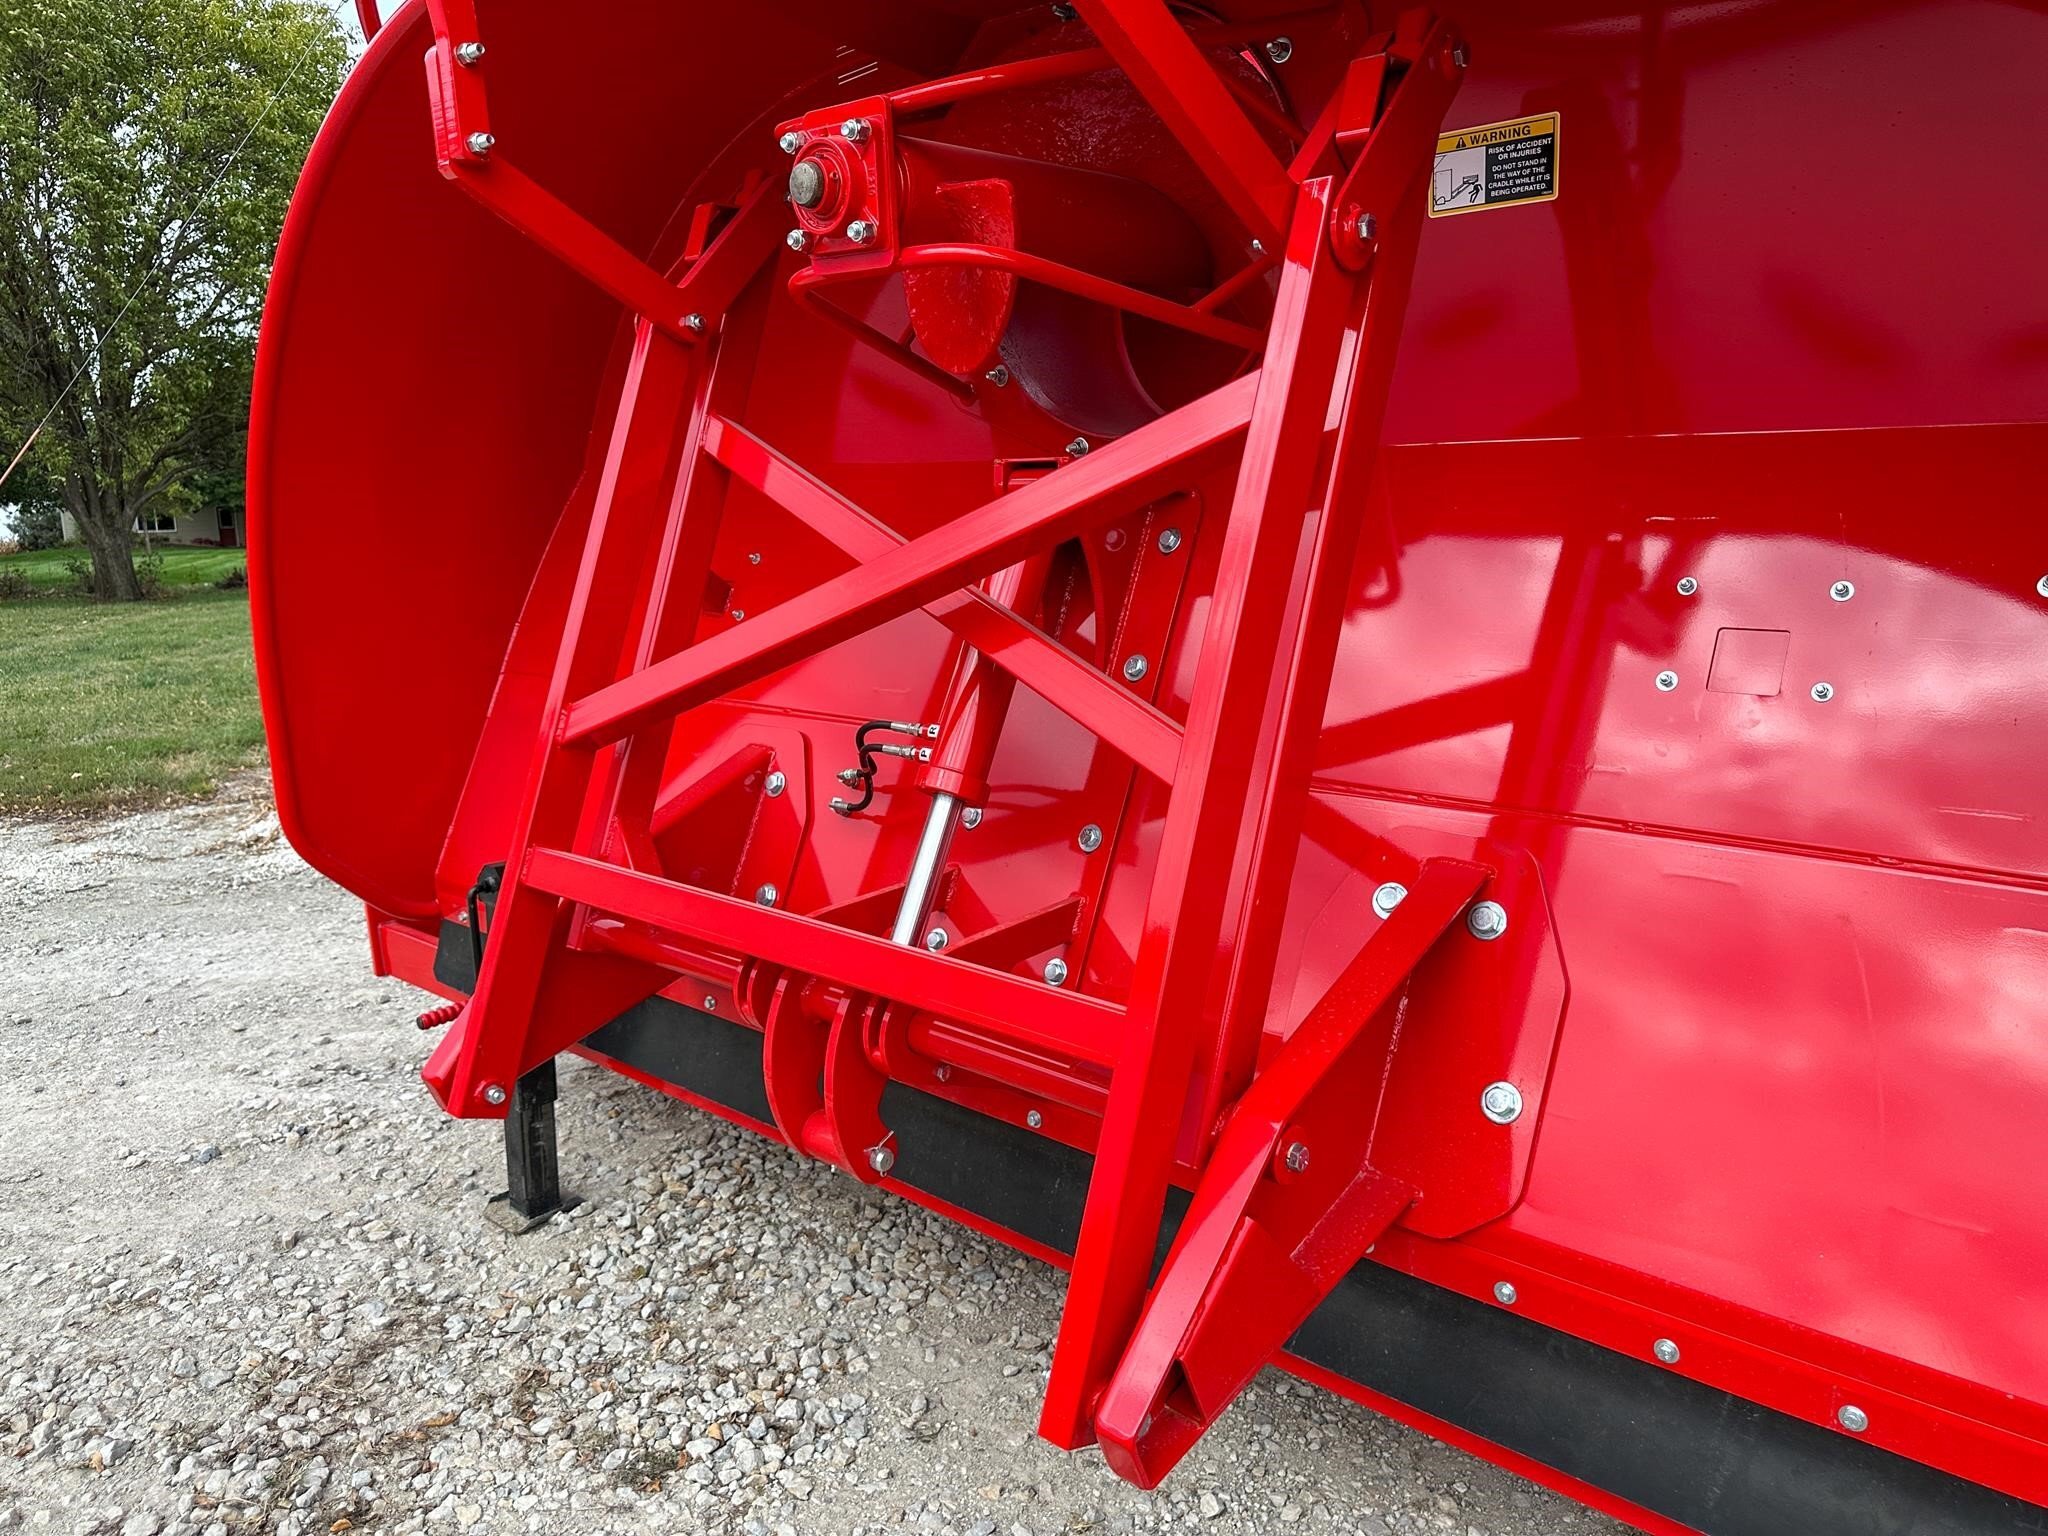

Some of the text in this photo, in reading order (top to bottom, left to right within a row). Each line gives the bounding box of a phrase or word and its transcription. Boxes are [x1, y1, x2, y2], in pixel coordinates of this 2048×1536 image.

[1470, 126, 1530, 145] WARNING
[1488, 138, 1552, 154] RISK OF ACCIDENT
[1510, 148, 1541, 158] INJURIES
[1518, 159, 1538, 168] STAND
[1488, 180, 1514, 188] CRADLE
[1515, 176, 1535, 184] WHILE
[1490, 188, 1510, 196] BEING
[929, 726, 937, 734] R
